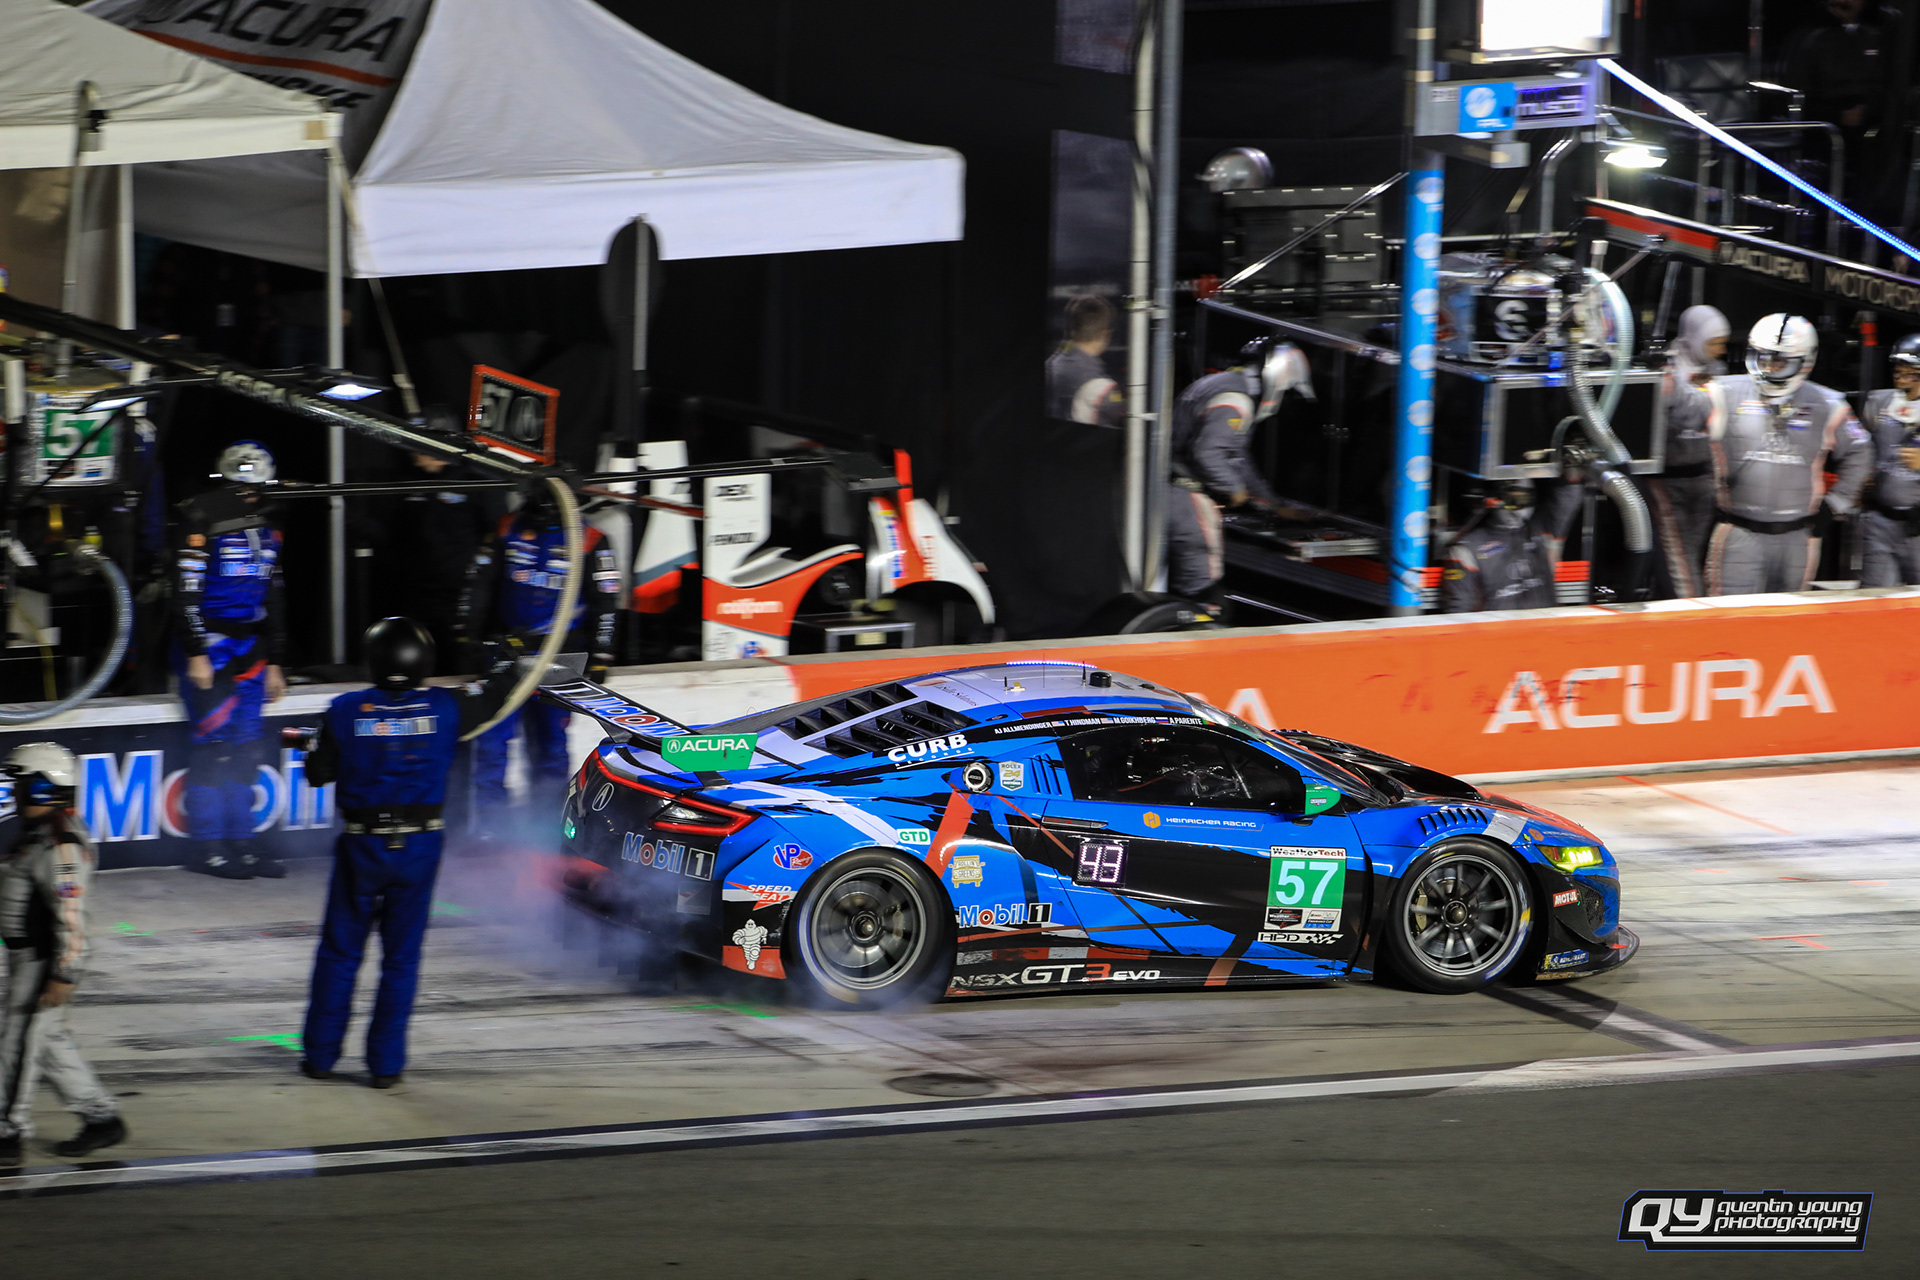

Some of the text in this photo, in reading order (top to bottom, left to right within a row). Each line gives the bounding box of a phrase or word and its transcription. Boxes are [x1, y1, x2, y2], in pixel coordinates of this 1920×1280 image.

[1481, 655, 1837, 734] ACURA
[1003, 721, 1053, 733] ALLMENDINGER
[681, 738, 750, 752] ACURA
[888, 734, 968, 762] CURB
[895, 747, 972, 766] RECORDS
[900, 831, 929, 842] GTD
[621, 831, 686, 874] Mobil
[774, 843, 801, 869] VP
[1272, 847, 1344, 857] WeatherTech
[1080, 844, 1124, 883] 43
[747, 884, 791, 893] SPEED
[1275, 860, 1339, 905] 57
[752, 892, 785, 901] SEAT
[1554, 891, 1578, 905] MOTUL
[959, 903, 1025, 928] Mobil
[1260, 933, 1301, 942] HPD
[950, 963, 1161, 988] NSX GT3 EVO
